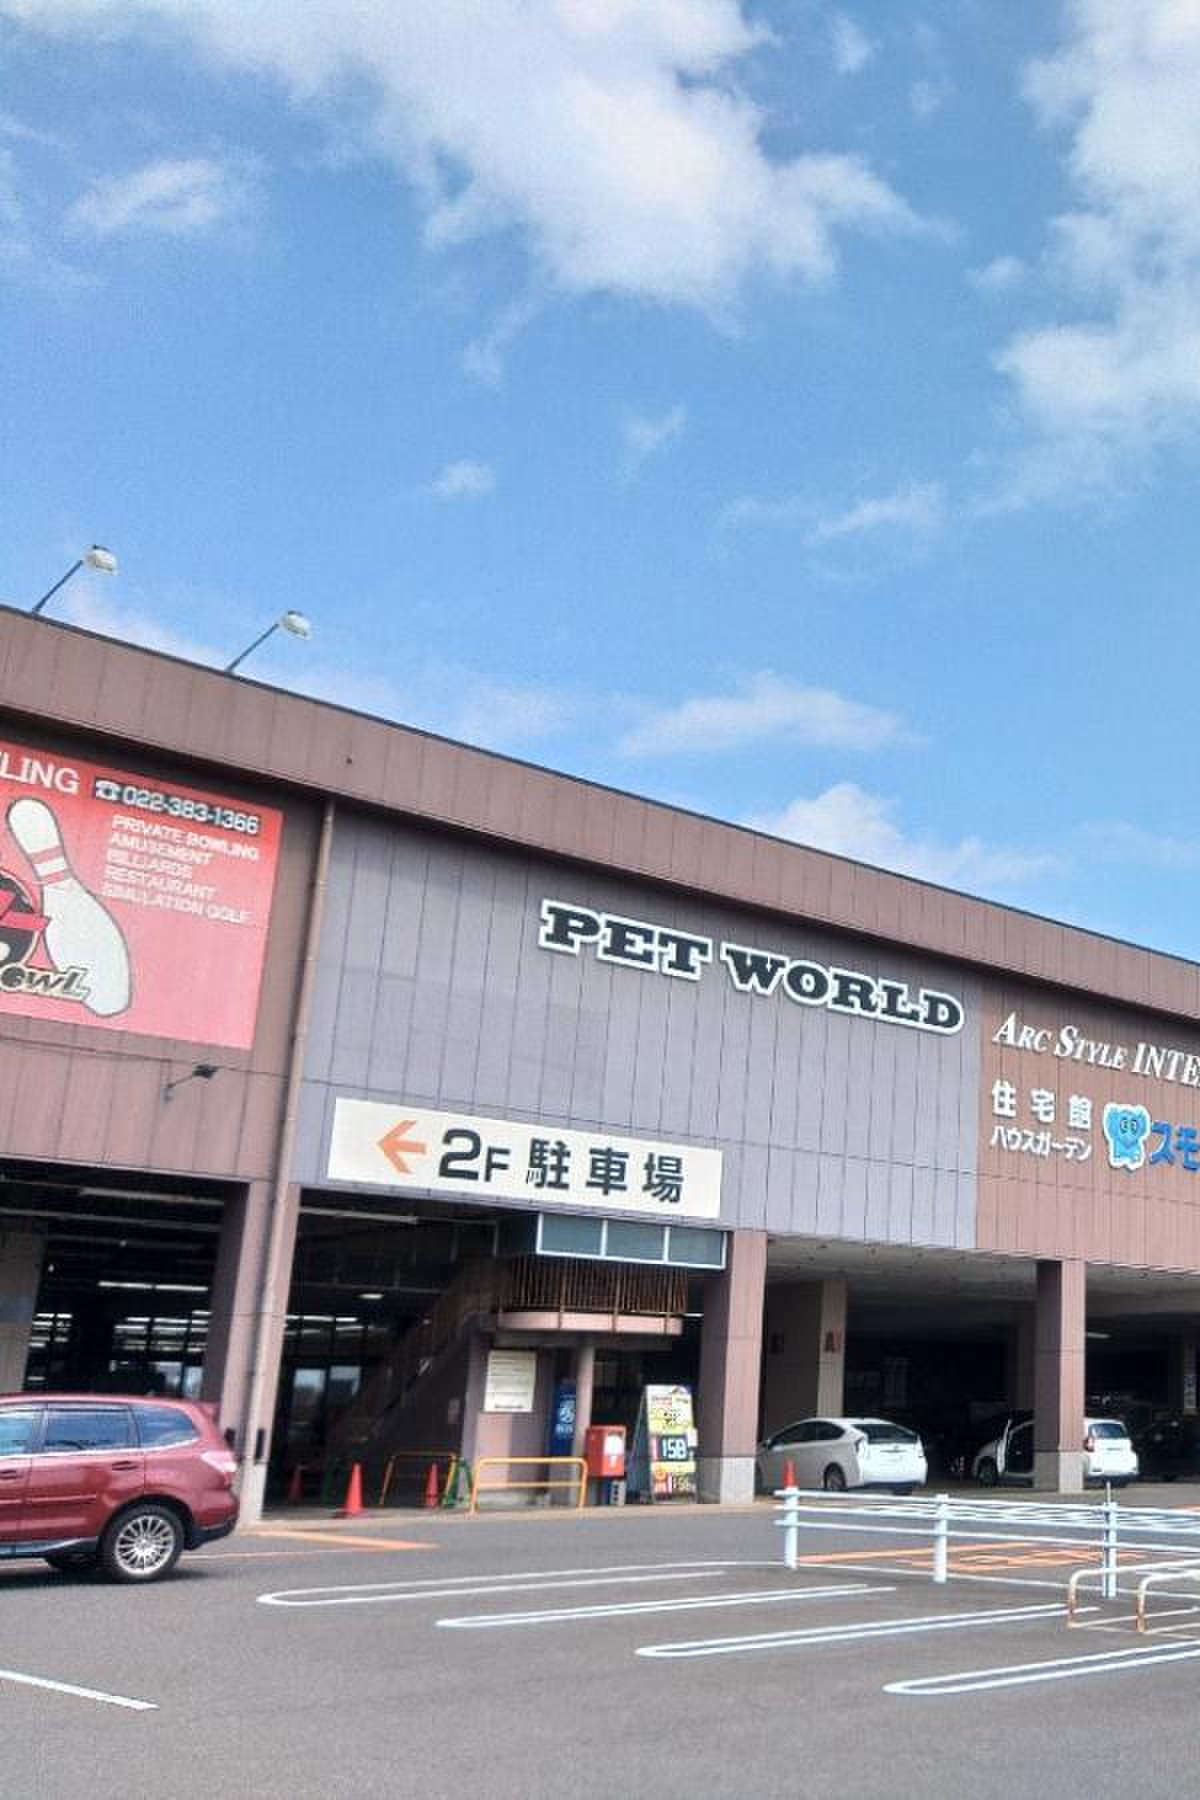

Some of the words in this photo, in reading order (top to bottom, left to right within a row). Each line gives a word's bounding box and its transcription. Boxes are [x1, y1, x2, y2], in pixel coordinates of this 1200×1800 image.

[0, 752, 81, 795] LING
[110, 831, 213, 865] AMUSEMENT
[111, 814, 185, 846] PRIVATE
[186, 831, 260, 861] BOWLING
[539, 899, 712, 981] PET
[720, 941, 964, 1035] WORLD
[438, 1128, 511, 1182] 2F
[527, 1137, 685, 1204] 駐車場
[991, 1126, 1092, 1162] ハウスガーデン
